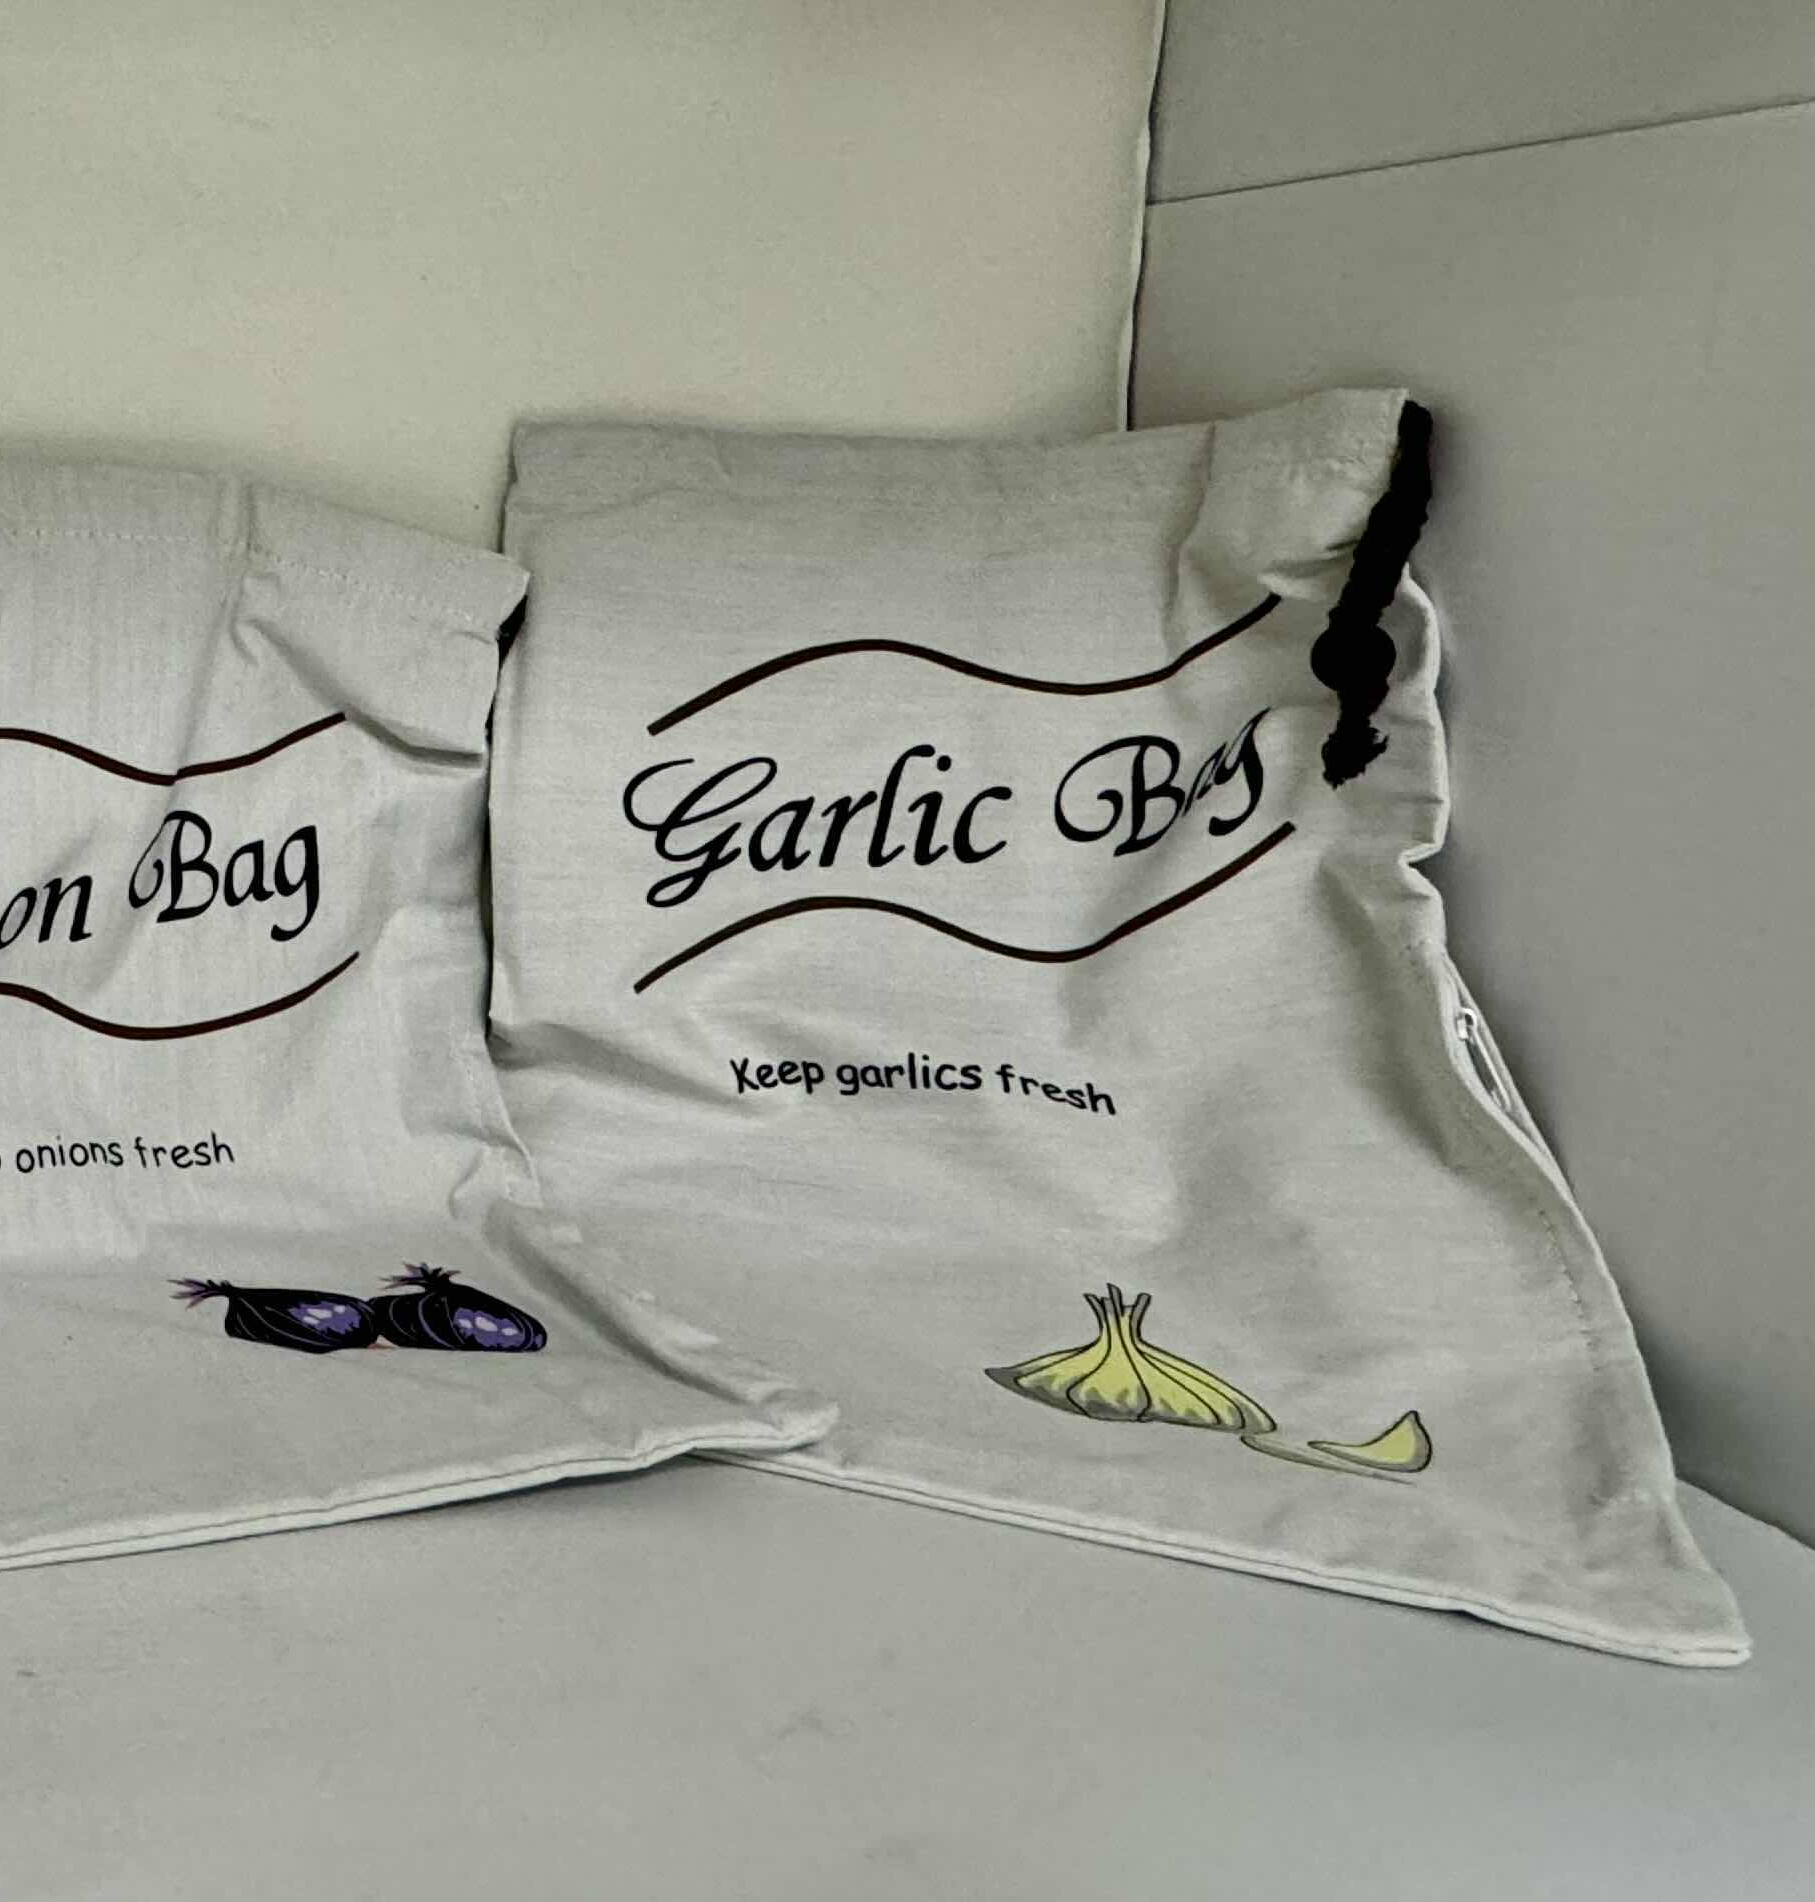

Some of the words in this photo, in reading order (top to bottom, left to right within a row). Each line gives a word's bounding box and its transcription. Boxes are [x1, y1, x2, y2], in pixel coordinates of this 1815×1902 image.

[621, 743, 1014, 908] Garlic
[127, 809, 321, 943] Bag
[728, 1056, 826, 1096] Keep
[835, 1050, 983, 1097] garlics
[994, 1062, 1117, 1116] fresh
[15, 1134, 125, 1175] onions
[133, 1131, 235, 1170] fresh
